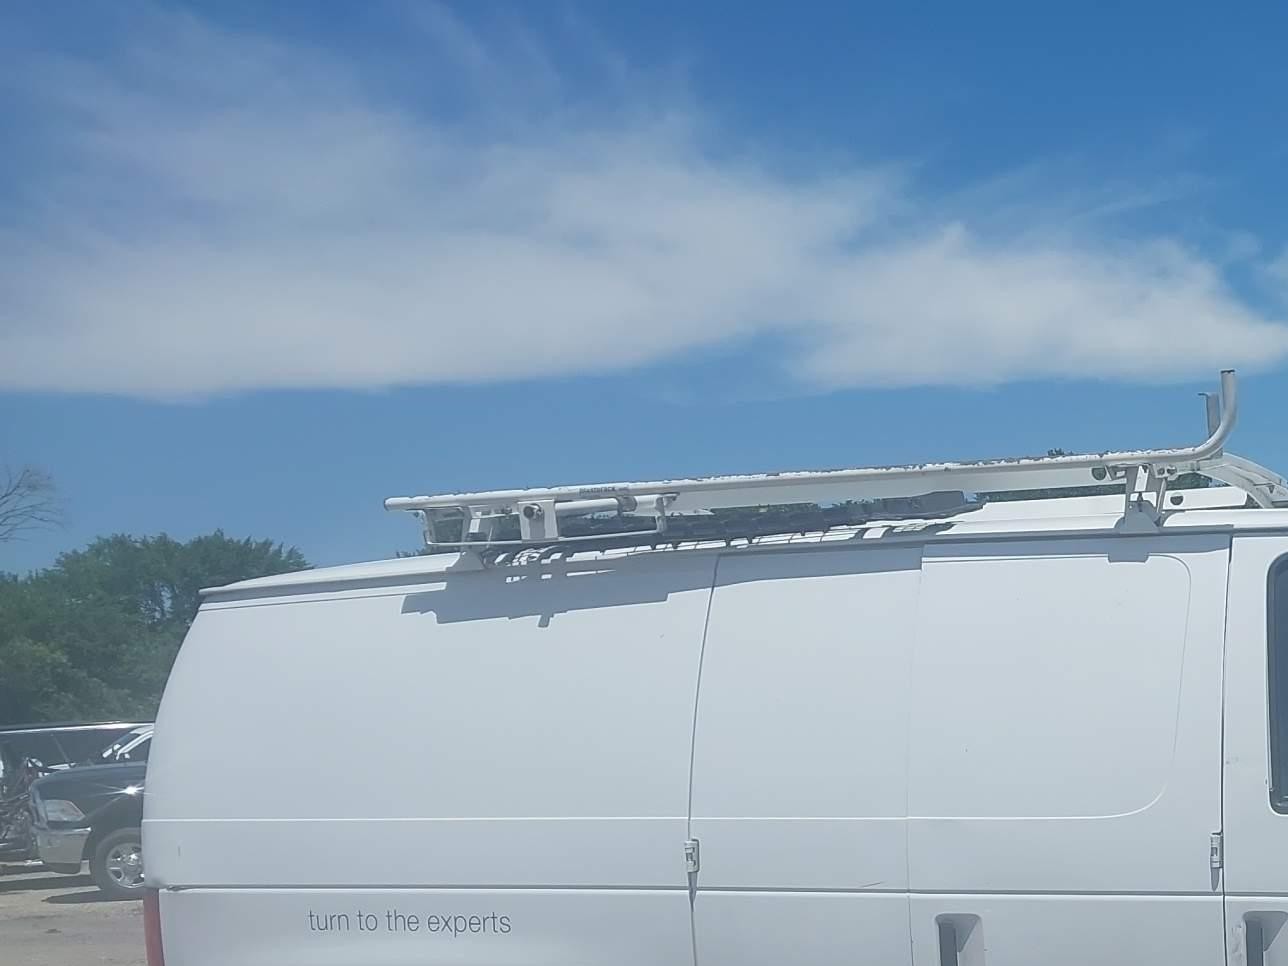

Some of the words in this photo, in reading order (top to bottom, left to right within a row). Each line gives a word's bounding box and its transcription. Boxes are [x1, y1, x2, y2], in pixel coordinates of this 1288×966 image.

[307, 909, 349, 931] turn
[356, 910, 378, 931] to
[385, 909, 419, 932] the
[427, 912, 512, 938] experts
